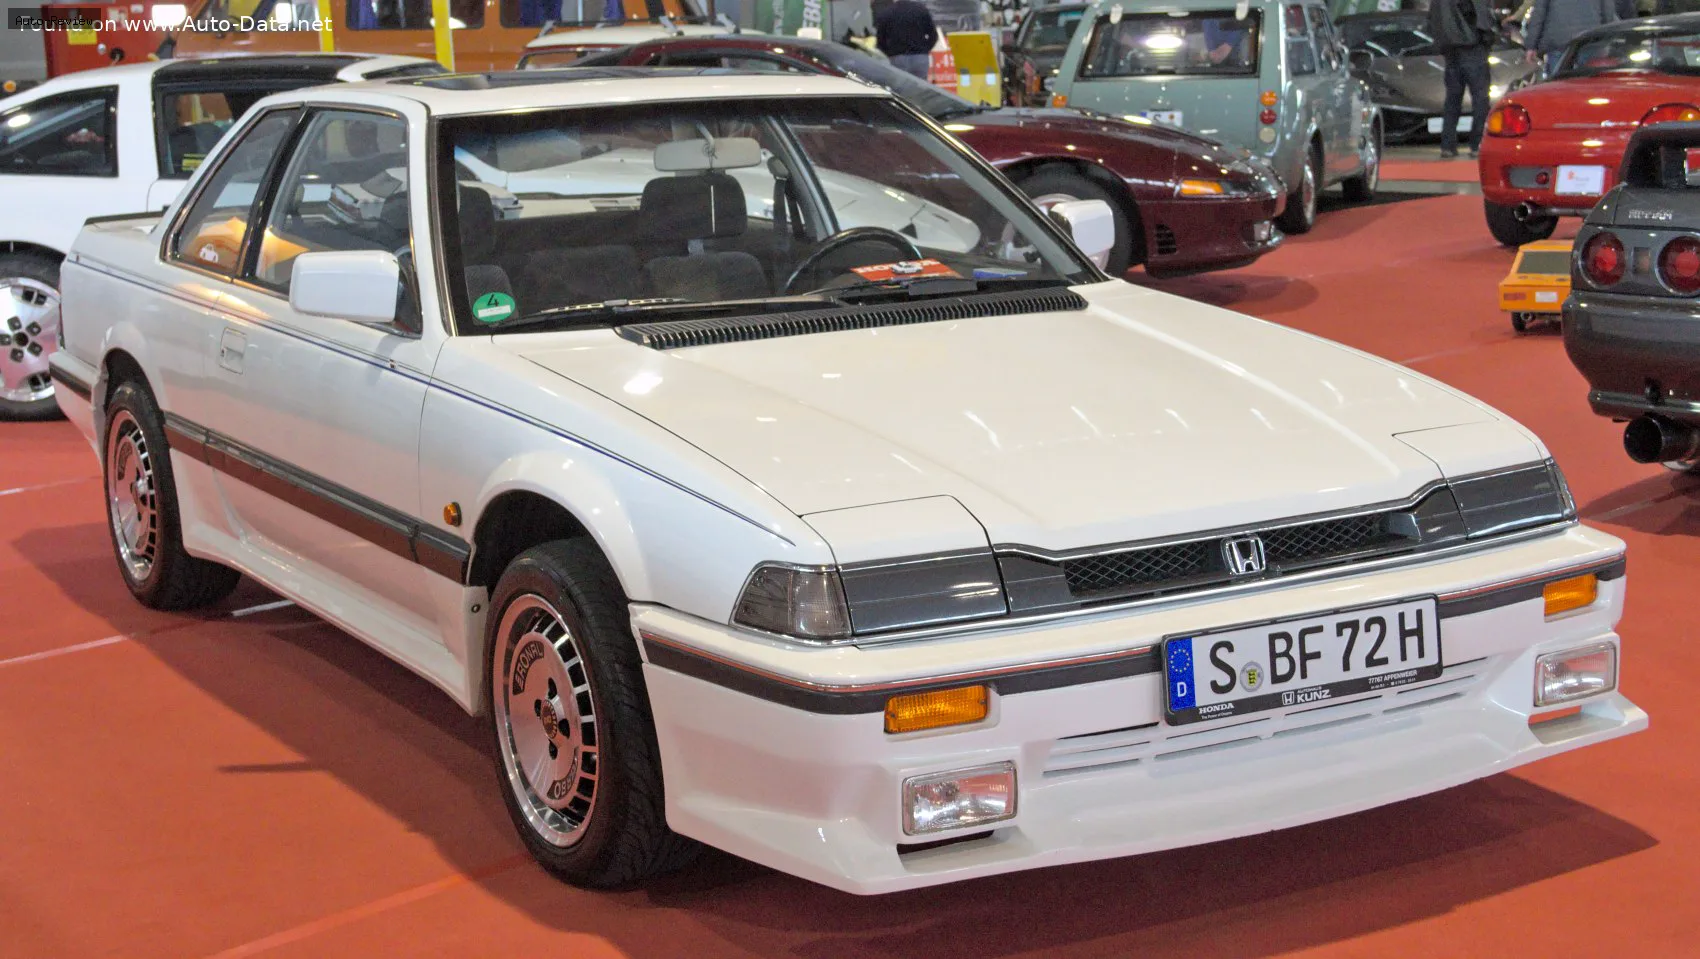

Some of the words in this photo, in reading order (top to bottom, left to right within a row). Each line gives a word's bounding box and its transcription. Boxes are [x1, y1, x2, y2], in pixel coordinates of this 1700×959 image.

[487, 294, 499, 306] 4
[1209, 640, 1237, 695] S
[1268, 624, 1324, 685] BF
[1177, 681, 1187, 698] D
[1199, 703, 1235, 714] HONDA
